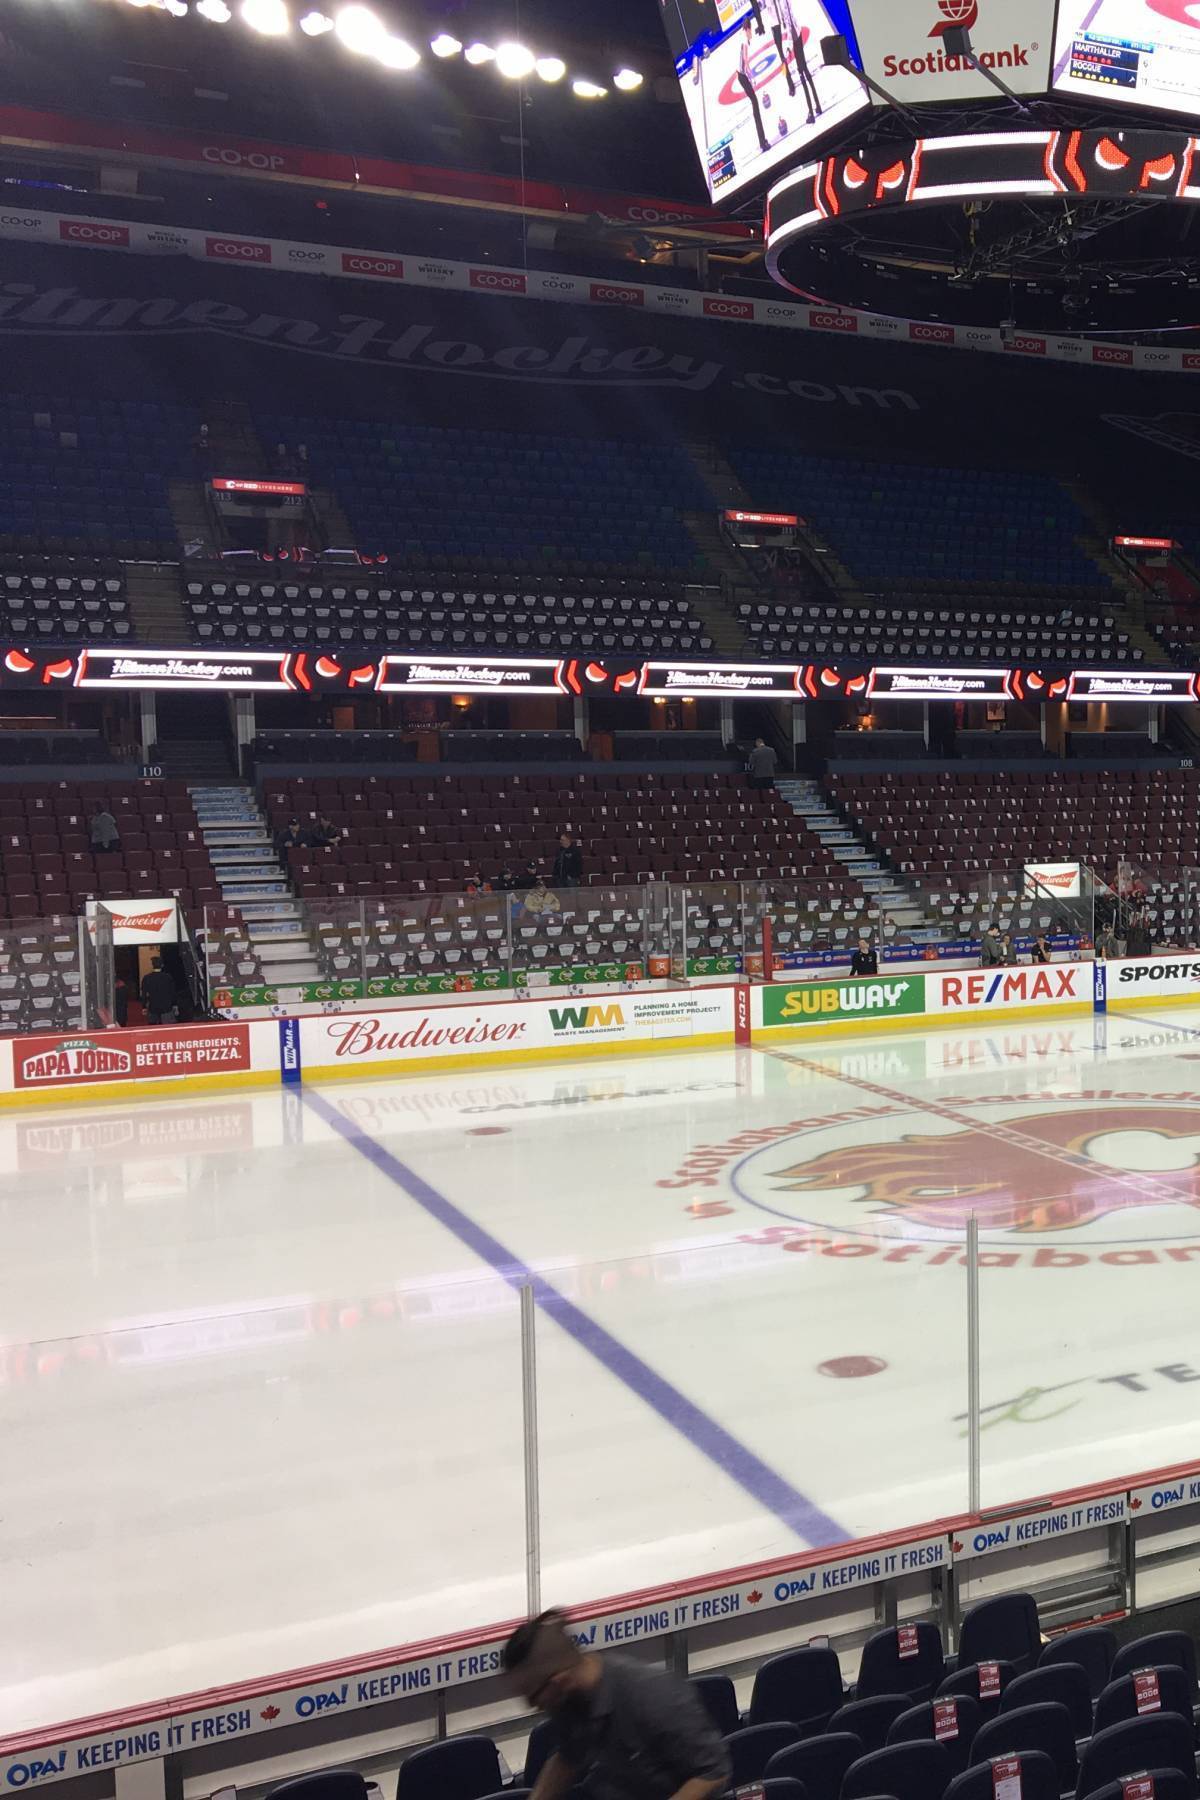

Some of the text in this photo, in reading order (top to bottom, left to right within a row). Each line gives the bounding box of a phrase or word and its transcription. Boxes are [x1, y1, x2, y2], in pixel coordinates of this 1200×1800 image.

[0, 282, 920, 411] itmenHockey.com
[110, 914, 168, 927] udweiser
[780, 981, 910, 1018] SUBWAY
[941, 968, 1078, 1007] RE/MAX
[548, 1004, 625, 1030] WM
[737, 990, 747, 1030] CCM
[62, 1039, 91, 1049] PIZZA
[135, 1036, 242, 1053] BETTER INGREDIENTS.
[327, 1016, 526, 1057] Budweiser
[26, 1050, 130, 1078] PAPA JOHNS
[136, 1047, 243, 1067] BETTER PIZZA.
[655, 1103, 896, 1190] Scotiabank
[973, 1498, 1125, 1553] OPA! KEEPING IT FRESH
[773, 1543, 944, 1602] OPA! KEEPING IT FRESH
[6, 1710, 251, 1788] OPA! KEEPING IT FRESH
